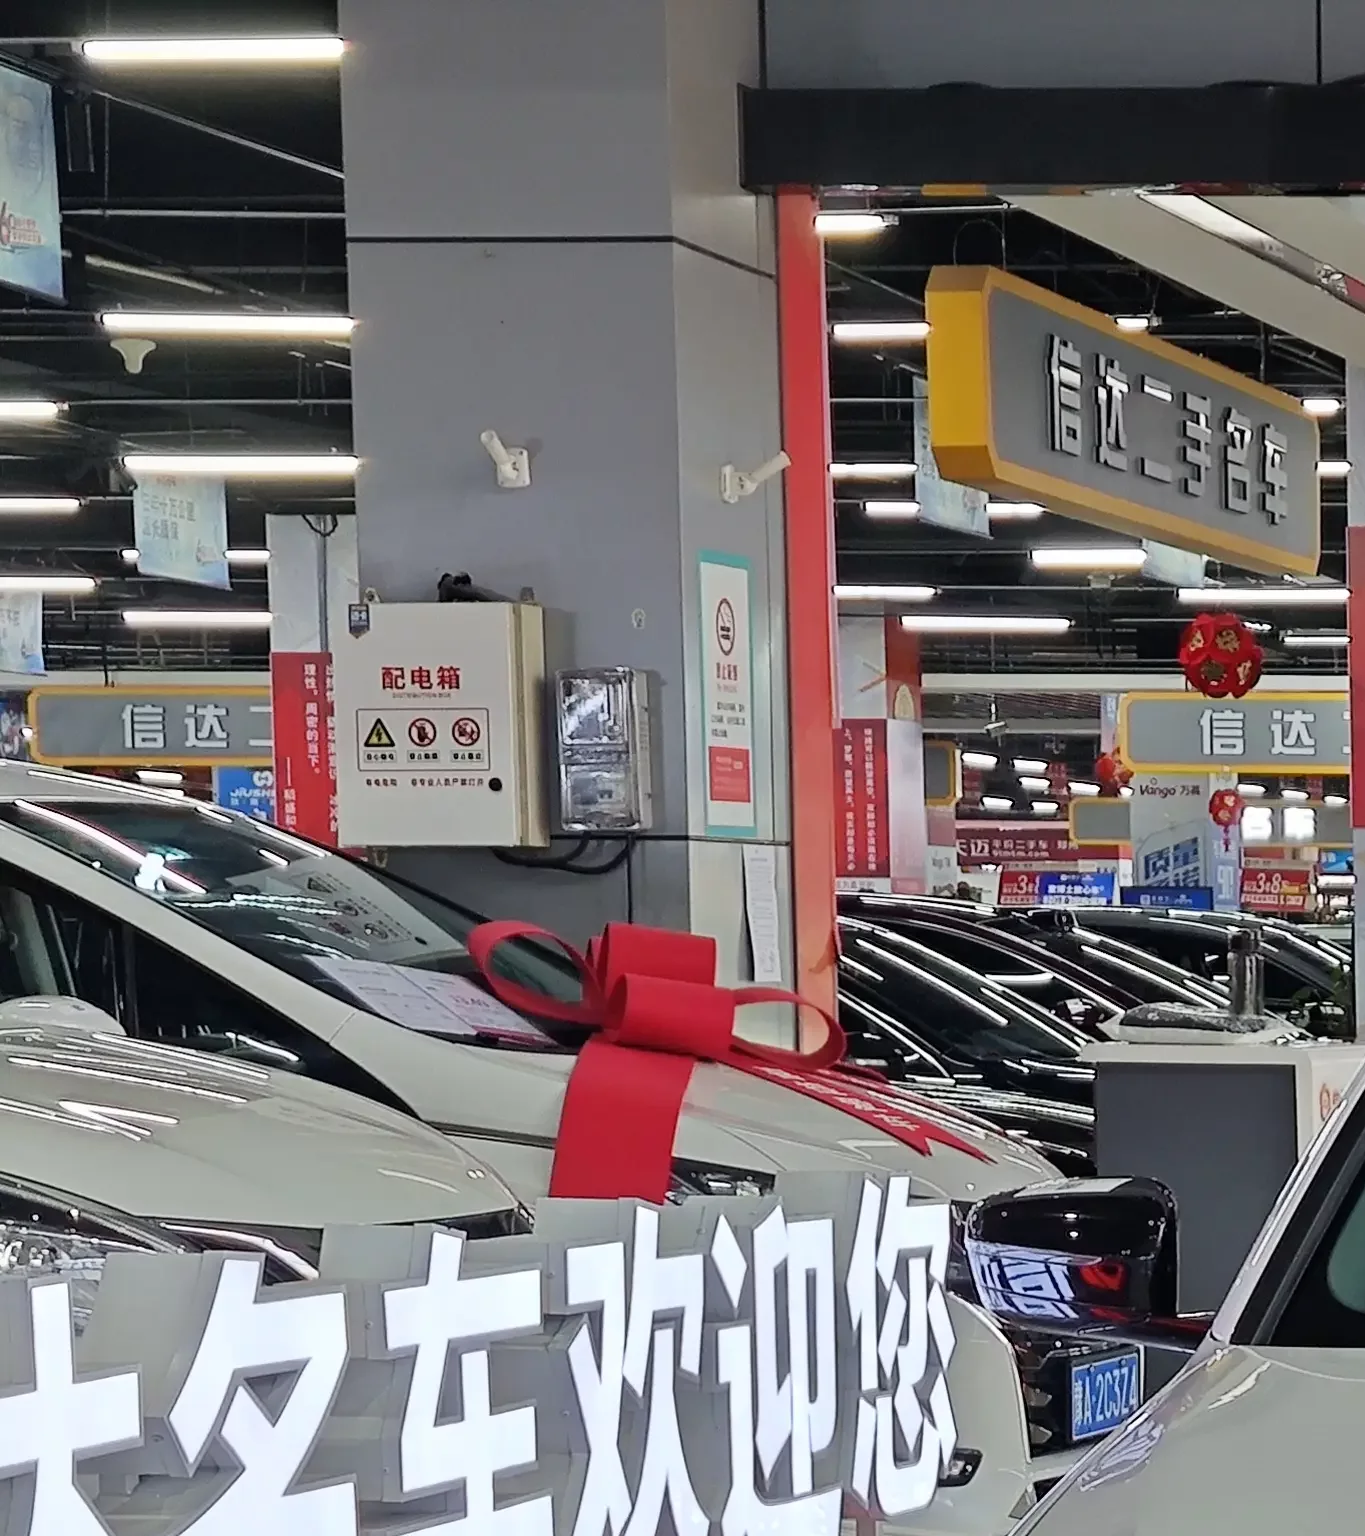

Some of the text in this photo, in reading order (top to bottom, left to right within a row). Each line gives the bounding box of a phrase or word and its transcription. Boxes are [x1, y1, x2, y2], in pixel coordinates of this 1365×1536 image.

[1047, 334, 1288, 525] 信达二手名车
[381, 666, 461, 690] 配电箱
[1140, 784, 1176, 799] Vango
